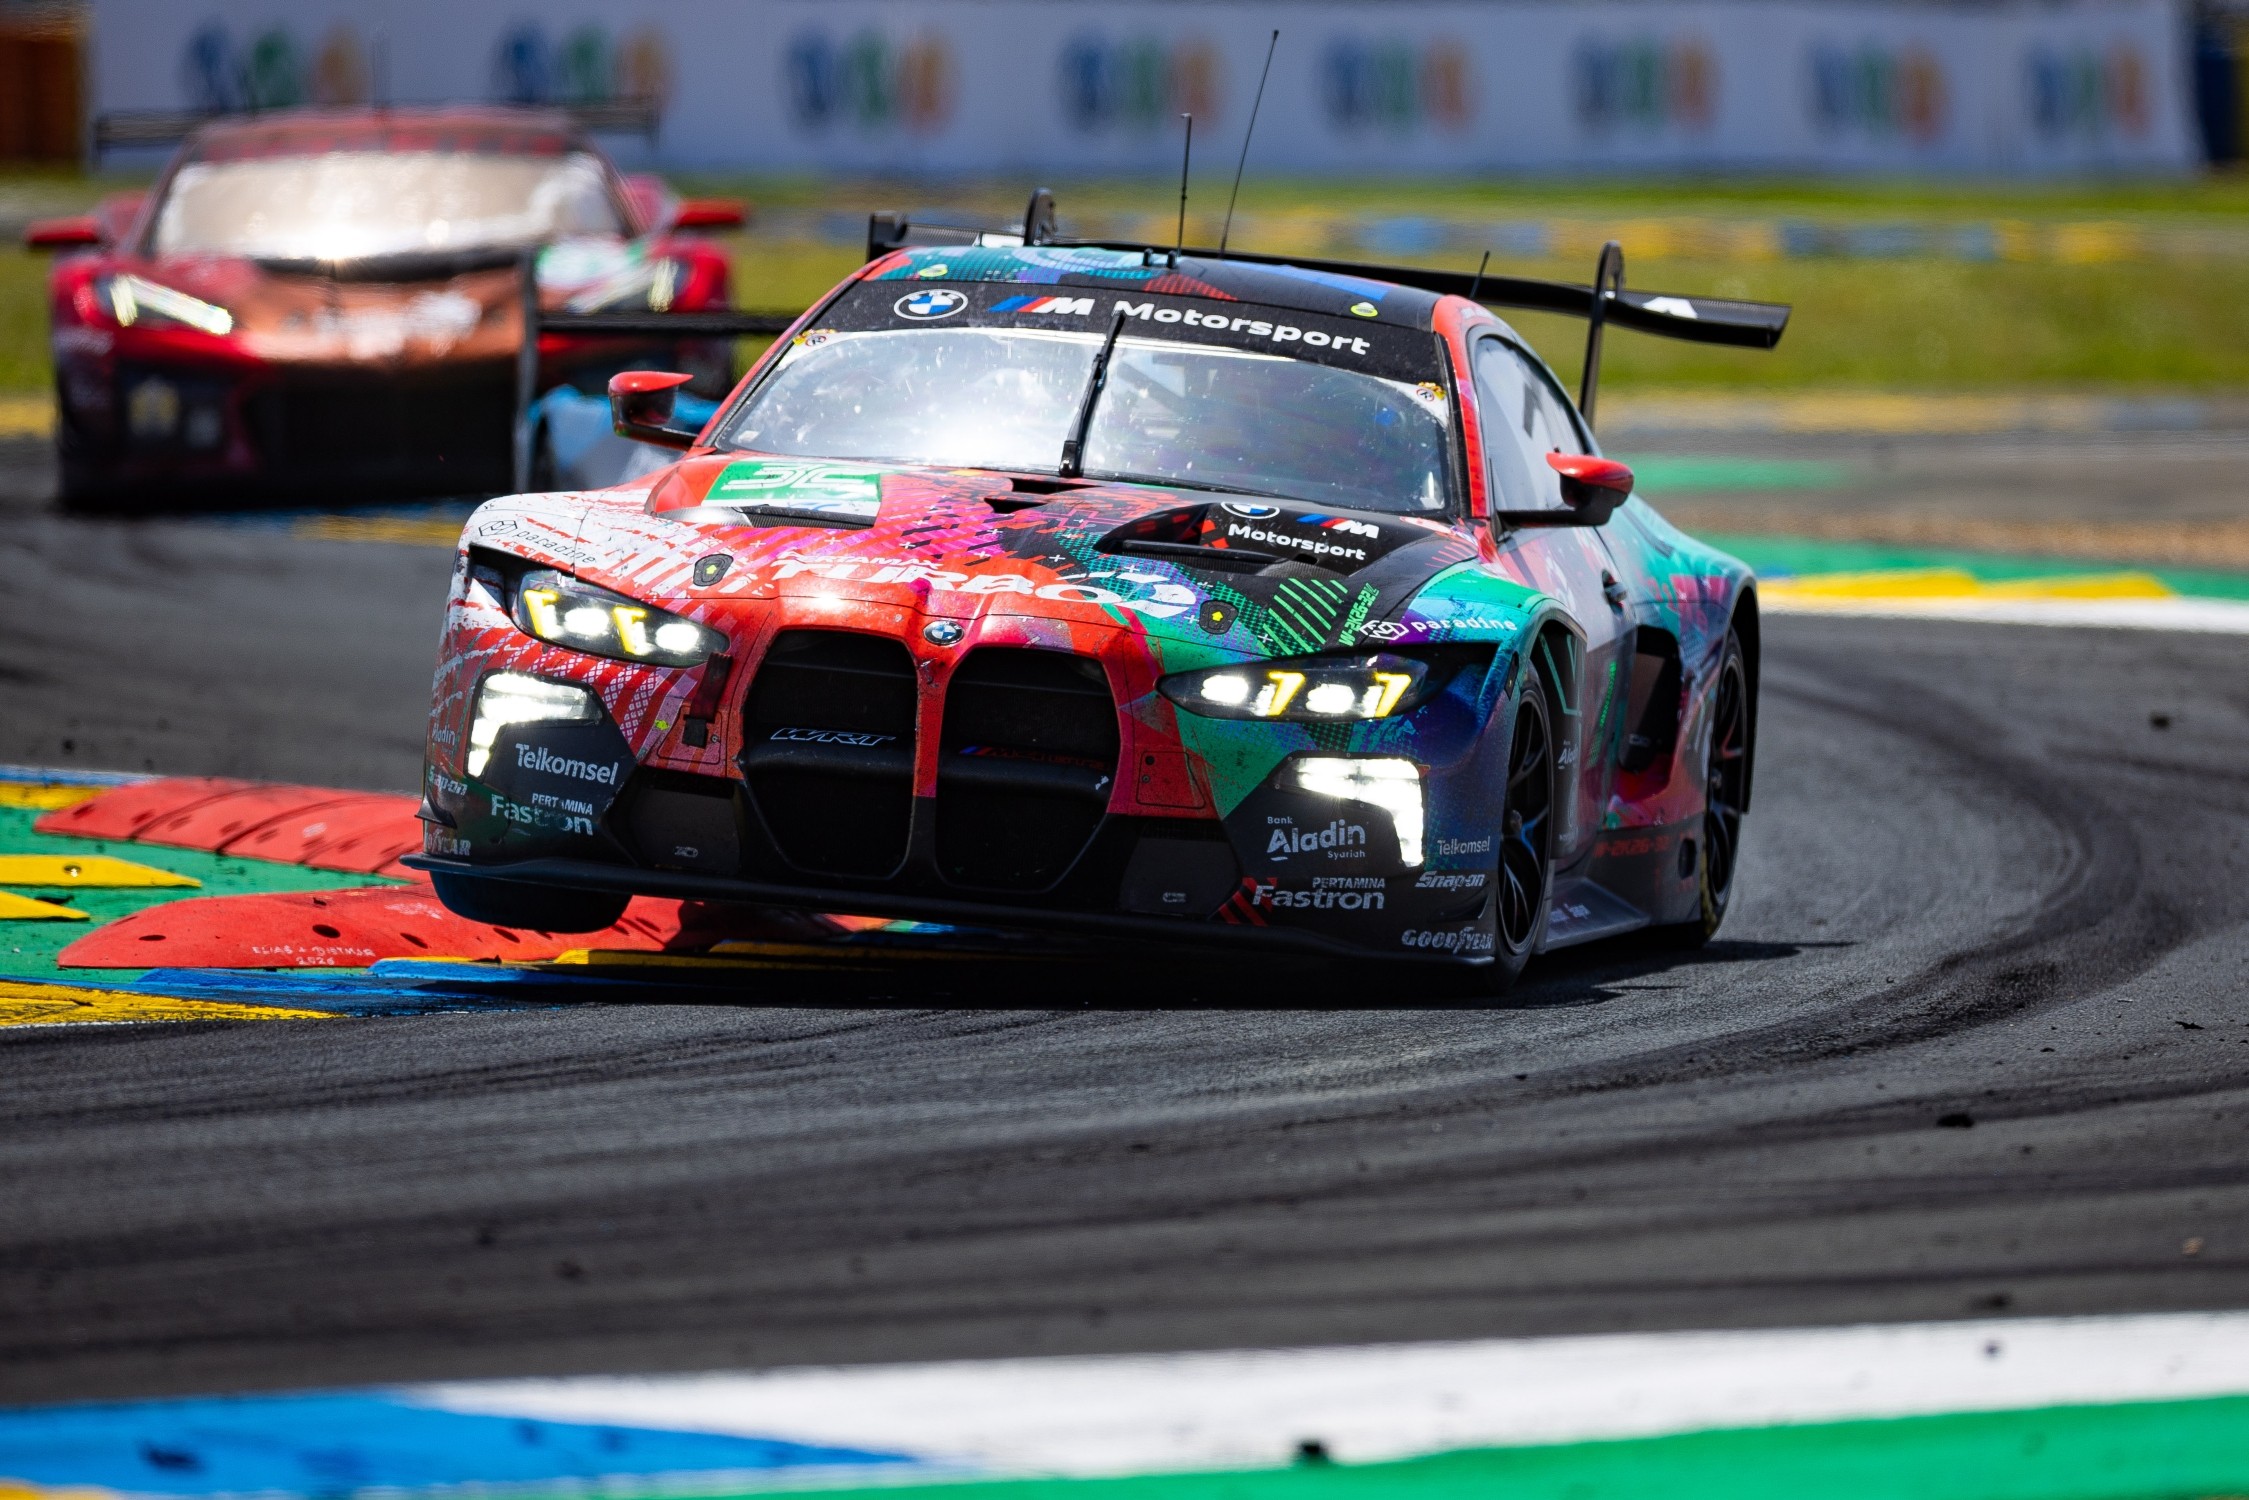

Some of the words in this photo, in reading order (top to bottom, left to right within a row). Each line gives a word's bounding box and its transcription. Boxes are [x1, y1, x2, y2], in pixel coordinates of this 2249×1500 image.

[1111, 300, 1371, 356] Motorsport
[512, 530, 596, 564] paradine
[1228, 523, 1367, 561] Motorsport
[770, 558, 1123, 605] TURBO
[1411, 615, 1518, 633] paradine
[770, 727, 897, 746] WRT
[515, 743, 619, 785] Telkomsel
[1267, 816, 1293, 825] Bank
[1267, 819, 1366, 854] Aladin
[1437, 836, 1491, 857] Telkomsel
[1312, 877, 1386, 889] PERTAMINA
[1252, 885, 1385, 910] Fastron
[1401, 926, 1494, 954] GOODYEAR
